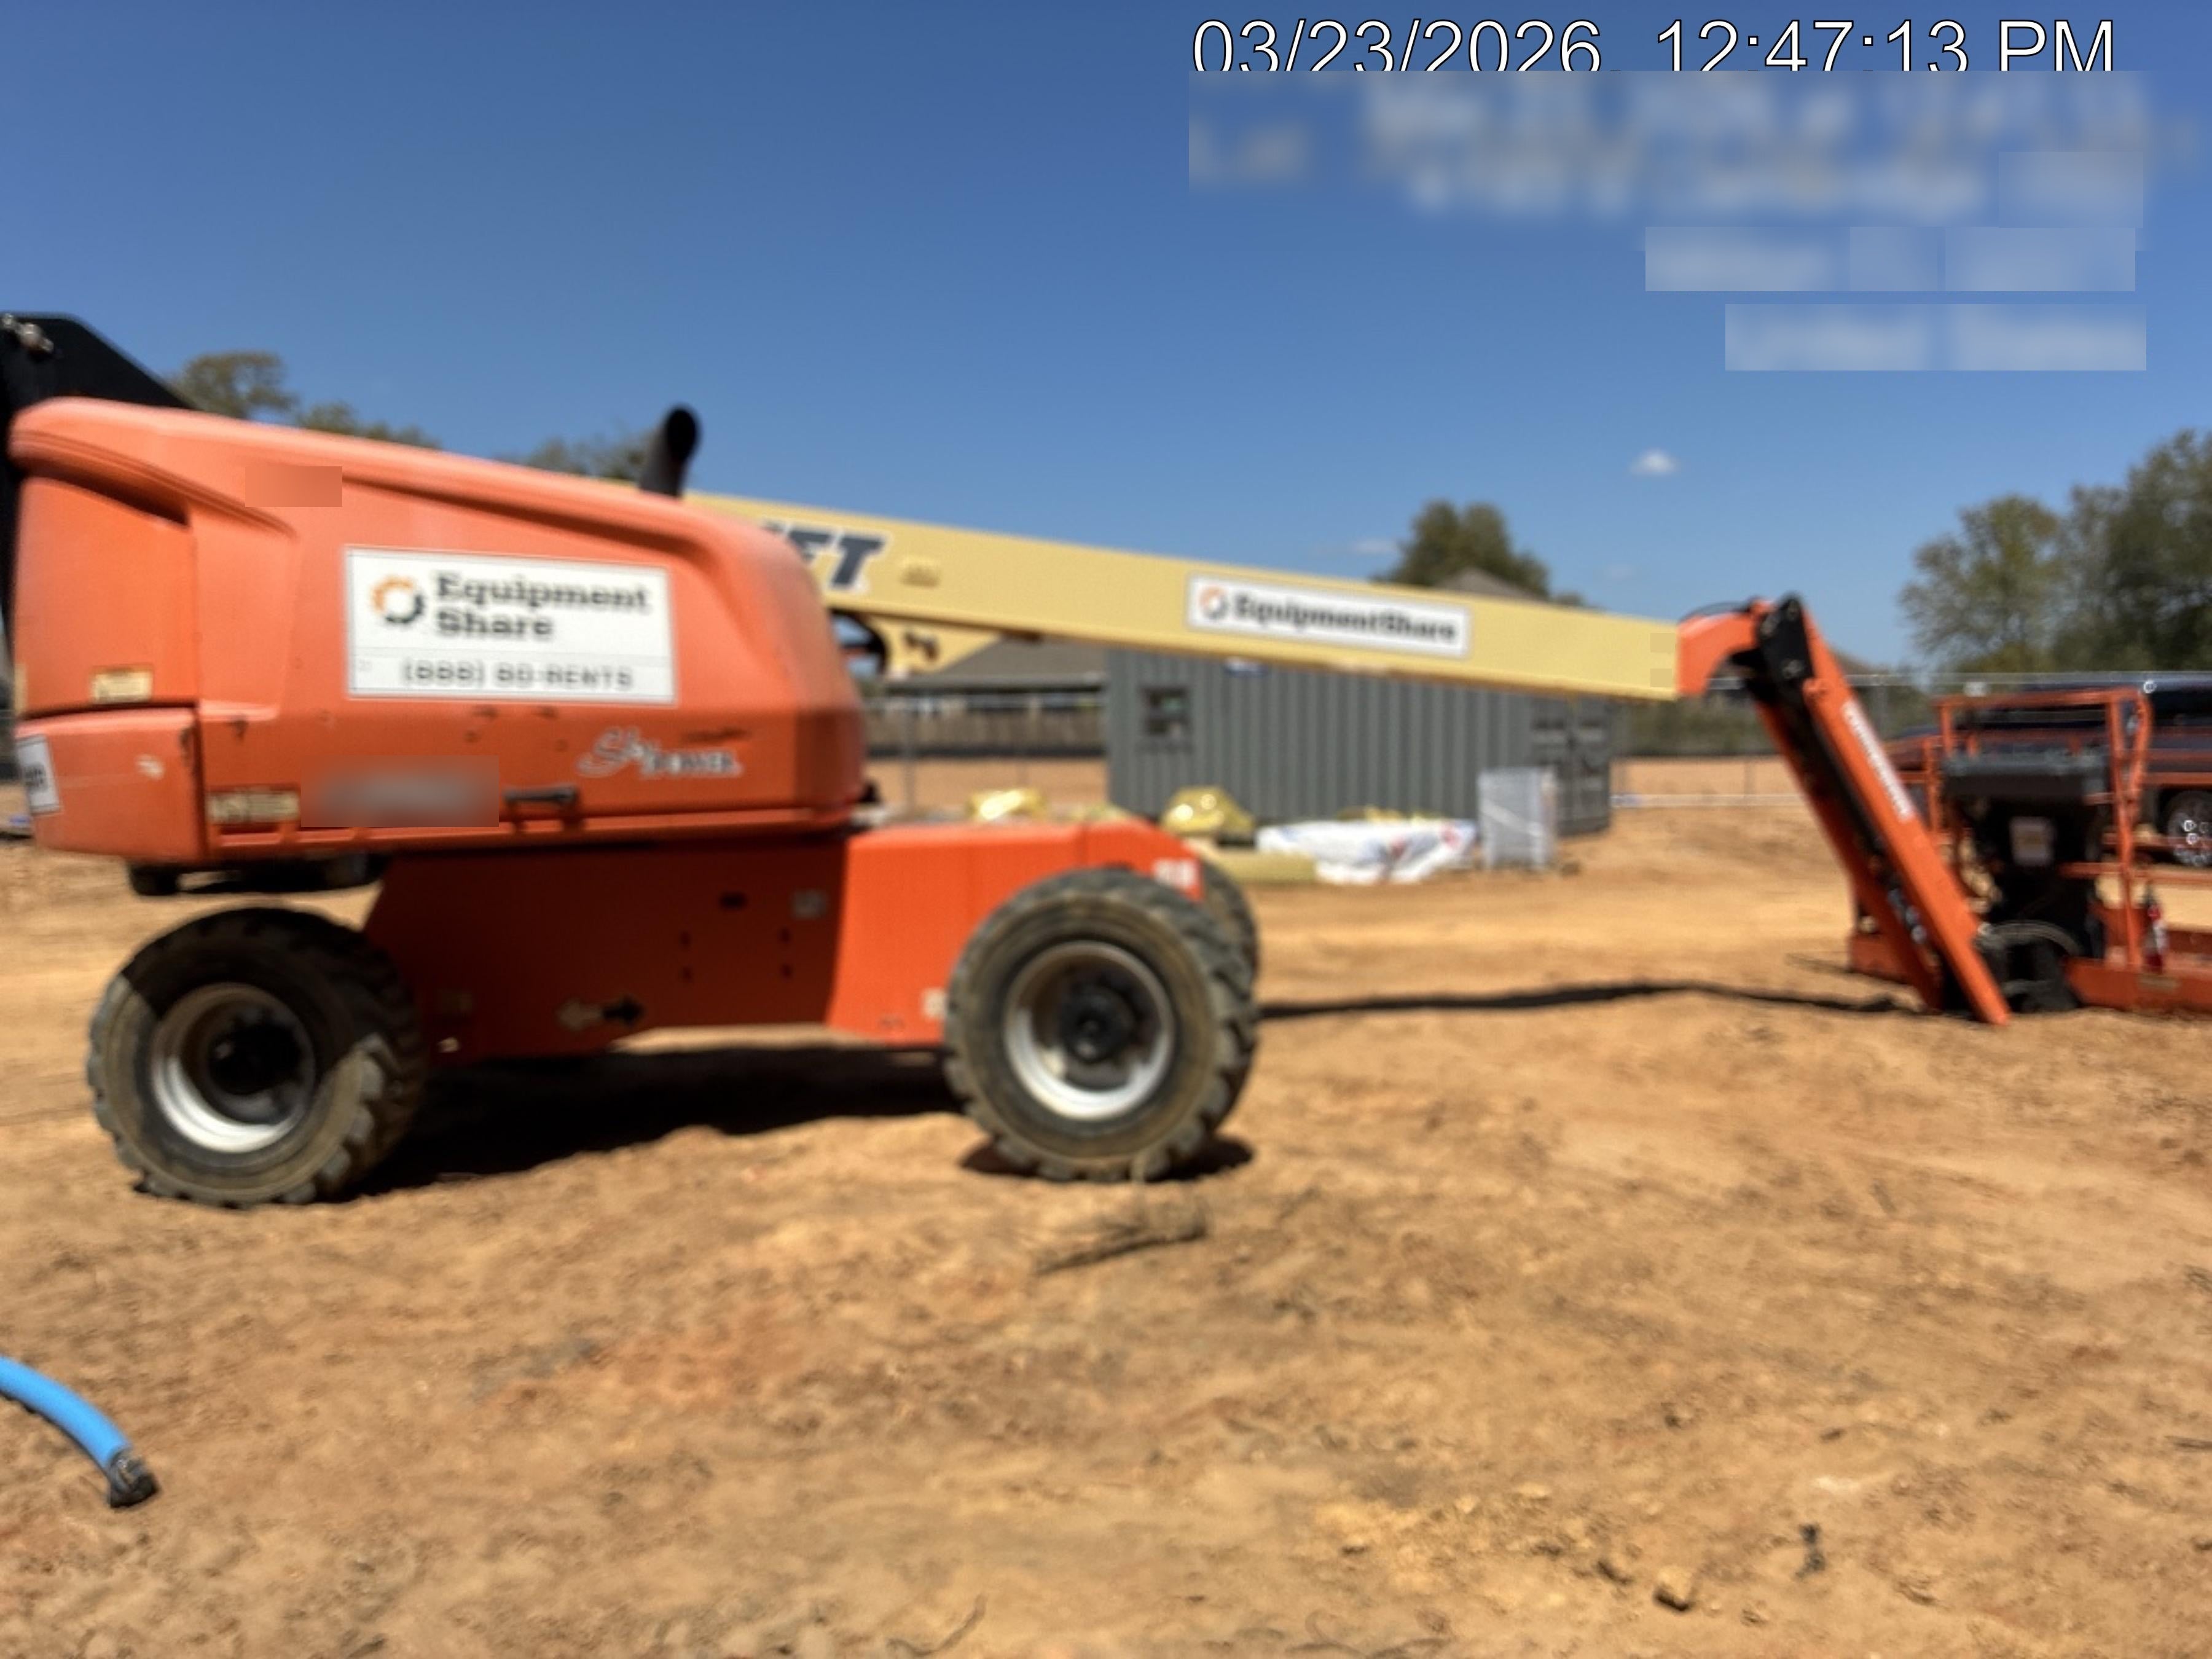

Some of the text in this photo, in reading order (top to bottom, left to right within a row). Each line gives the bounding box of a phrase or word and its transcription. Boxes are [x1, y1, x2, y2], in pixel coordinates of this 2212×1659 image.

[436, 573, 649, 610] Equipment
[435, 608, 554, 637] Share
[1234, 591, 1456, 644] EquipmentShare
